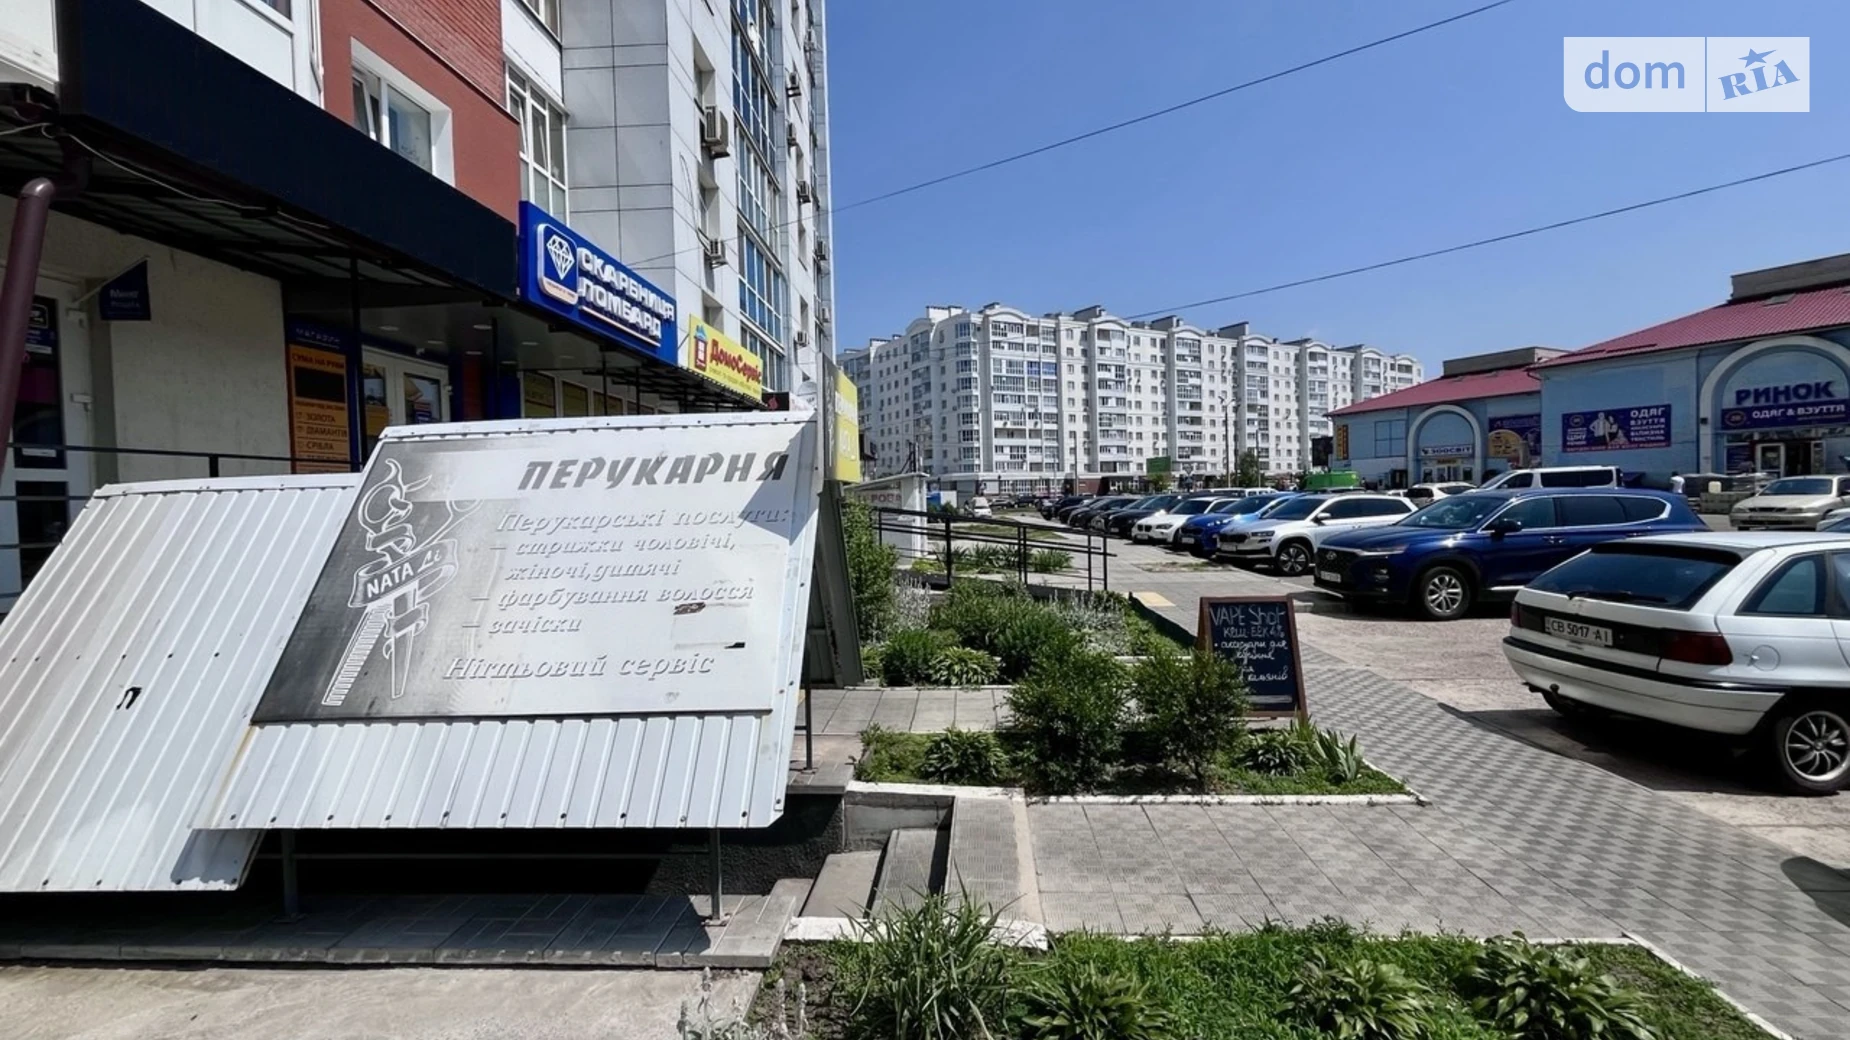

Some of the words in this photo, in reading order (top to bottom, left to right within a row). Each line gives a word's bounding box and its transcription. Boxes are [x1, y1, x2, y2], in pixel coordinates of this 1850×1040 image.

[577, 247, 674, 322] СКАРБНИЦЯ
[578, 276, 662, 340] ЛОМБАРД
[709, 338, 762, 385] ДомоСервіс
[1736, 381, 1836, 405] РИНОК
[1630, 407, 1665, 418] ОДЯГ
[1752, 408, 1785, 419] ОДЯГ
[1797, 404, 1845, 415] ВЗУТТЯ
[1432, 446, 1471, 456] ЗООСВІТ
[518, 451, 789, 491] ПЕРУКАРНЯ
[496, 510, 666, 536] Перукарські
[516, 540, 624, 559] стрижки
[634, 533, 736, 551] чоловічі,
[366, 562, 414, 598] NATA
[498, 588, 649, 611] фарбування
[656, 586, 755, 602] волосся
[488, 617, 582, 634] зачіски
[1209, 605, 1246, 626] VAPE
[1551, 619, 1564, 633] CB
[1567, 623, 1589, 639] 5017
[443, 655, 608, 680] Нігтьовий
[619, 653, 716, 681] сервіс
